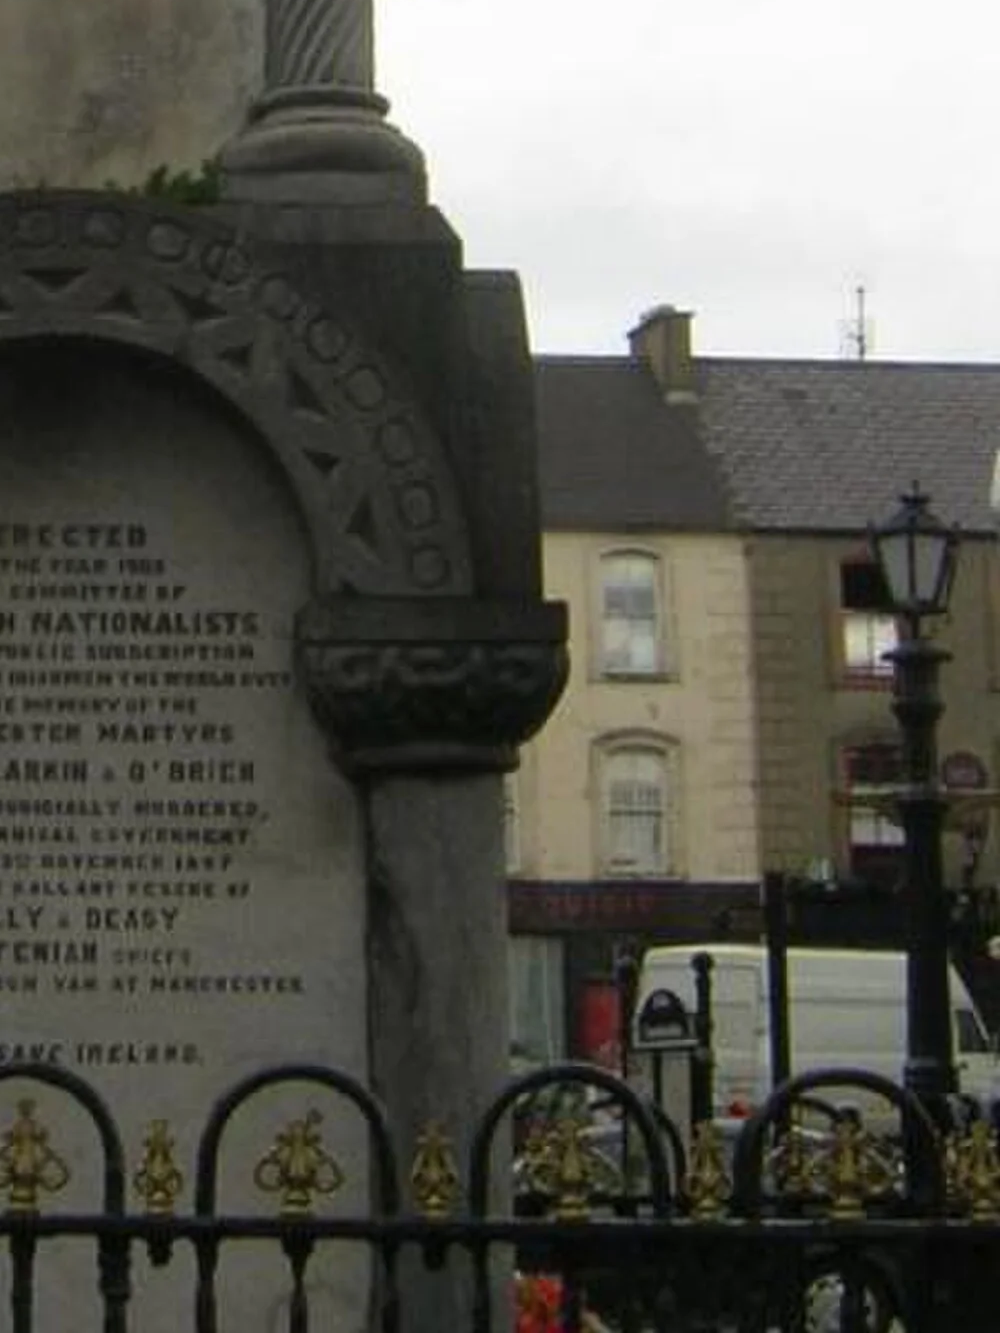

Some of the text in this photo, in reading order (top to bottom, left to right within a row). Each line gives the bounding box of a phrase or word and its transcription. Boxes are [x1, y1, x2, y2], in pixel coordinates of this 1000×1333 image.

[30, 611, 260, 637] NATIONALISTS
[98, 722, 235, 745] MARTYRS
[85, 906, 181, 931] DEASY
